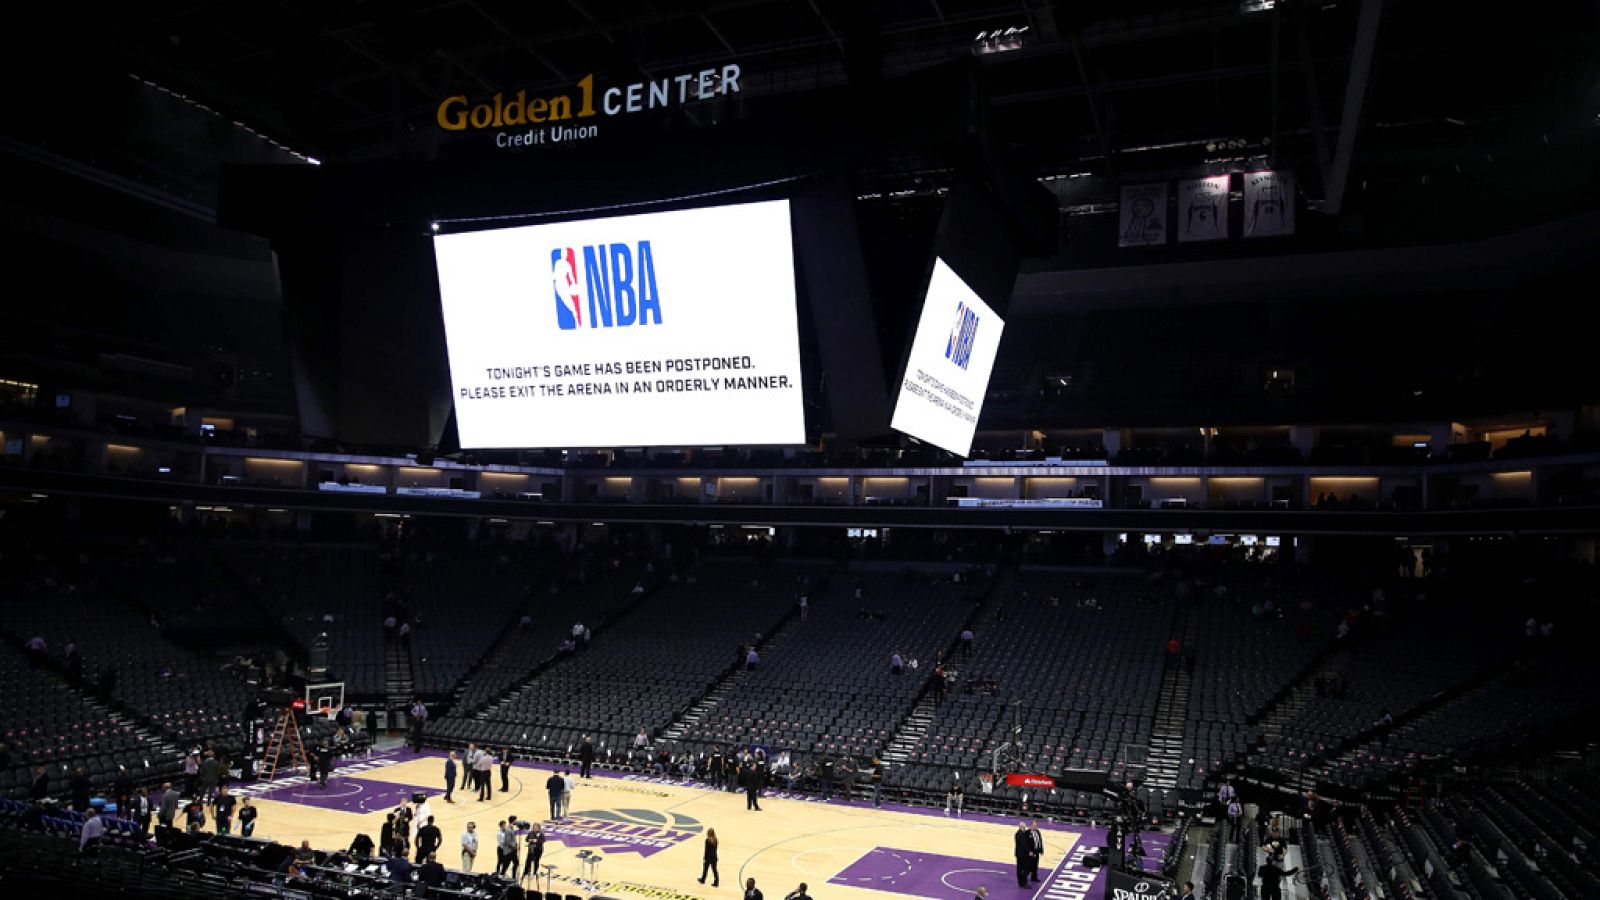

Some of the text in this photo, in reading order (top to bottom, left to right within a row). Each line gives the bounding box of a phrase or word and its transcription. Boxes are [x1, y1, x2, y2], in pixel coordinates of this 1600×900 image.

[437, 64, 741, 130] Golden 1 CENTER
[496, 124, 598, 148] Credit Union
[583, 240, 663, 328] NBA
[486, 355, 756, 380] TONIGHT'S GAME HAS BEEN POSTPONED.
[460, 375, 793, 399] PLEASE EXIT THE ARENA IN AN ORDERLY MANNER.
